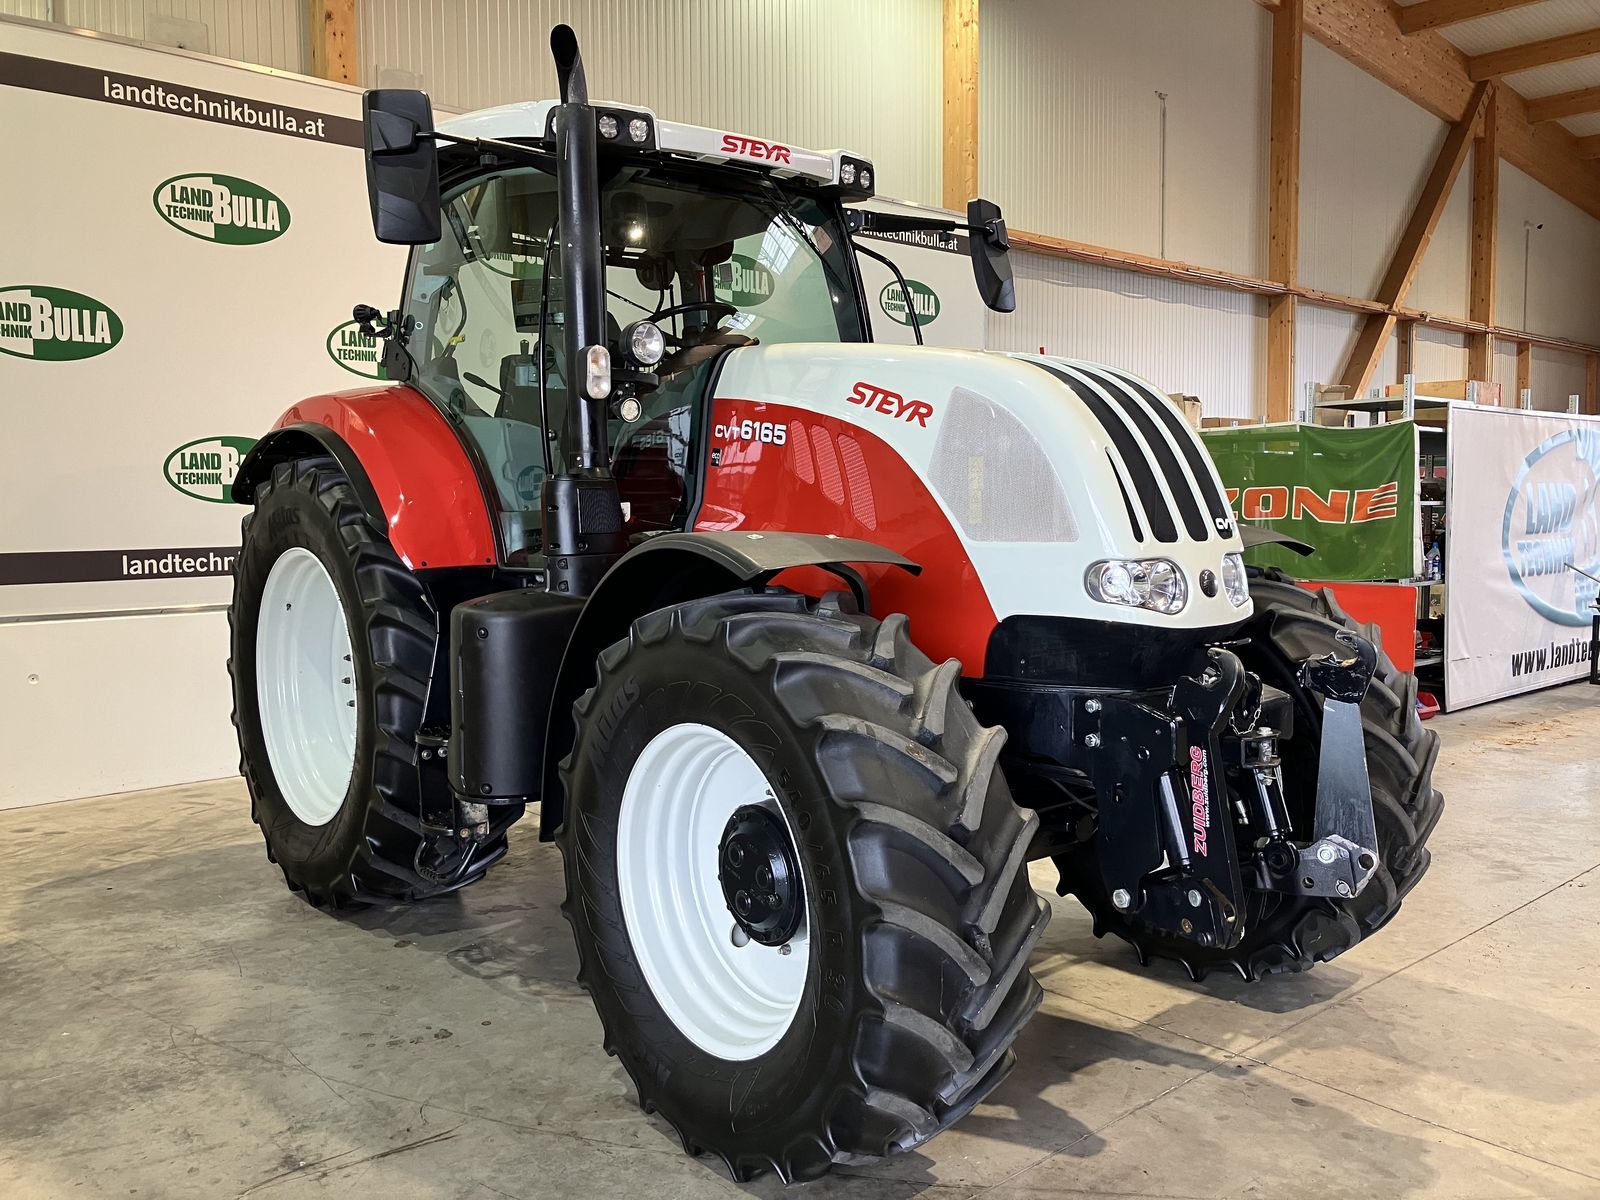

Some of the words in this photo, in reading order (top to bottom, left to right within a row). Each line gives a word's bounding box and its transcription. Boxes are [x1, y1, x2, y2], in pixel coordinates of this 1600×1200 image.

[103, 76, 325, 137] landtechnikbulla.at
[721, 135, 791, 164] STEYR
[170, 184, 213, 208] LAND
[212, 183, 280, 231] BULLA
[165, 204, 214, 223] TECHNIK
[732, 261, 769, 295] BULLA
[31, 296, 112, 344] BULLA
[337, 348, 378, 362] TECHNIK
[846, 382, 933, 428] STEYR
[715, 424, 740, 440] CVT
[740, 419, 787, 446] 6165
[180, 452, 222, 470] LAND
[175, 472, 222, 485] TECHNIK
[1525, 482, 1576, 535] LAND
[122, 551, 241, 575] landtechn
[1190, 745, 1207, 857] ZUIDBERG
